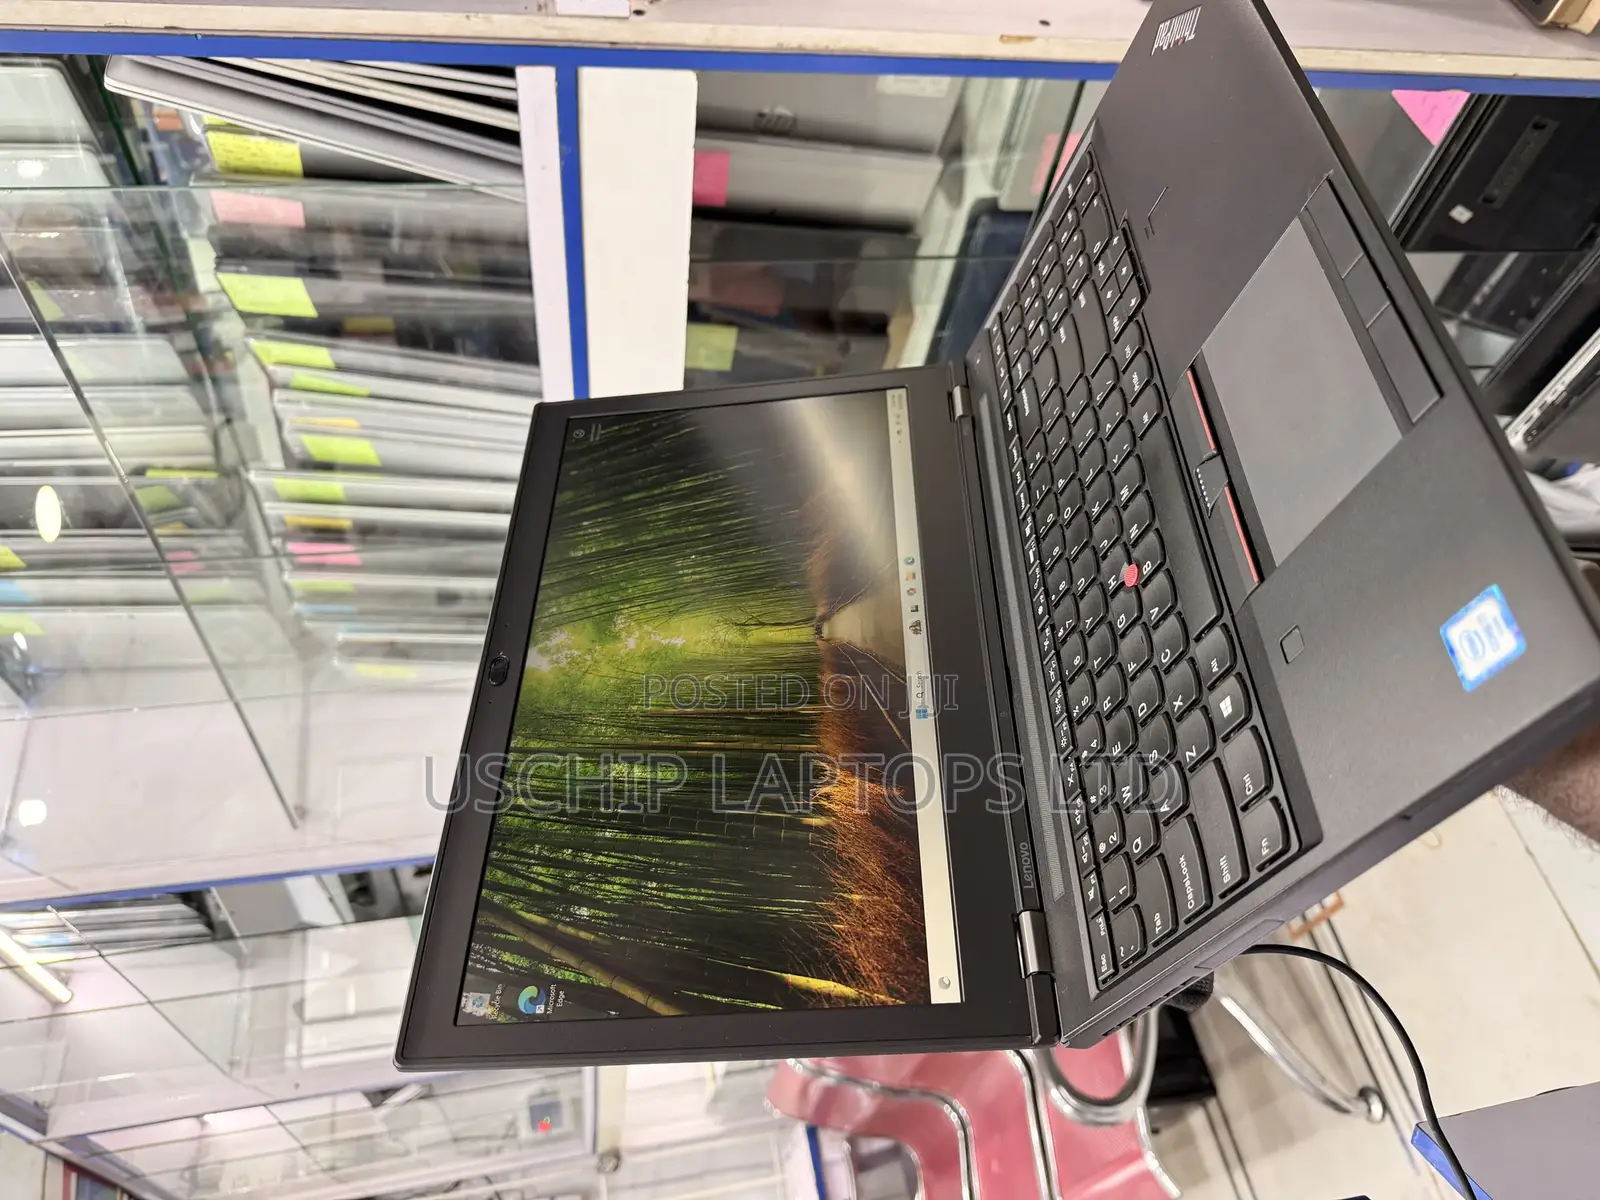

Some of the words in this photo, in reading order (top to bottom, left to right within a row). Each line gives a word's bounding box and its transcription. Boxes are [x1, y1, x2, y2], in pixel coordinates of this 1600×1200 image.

[1086, 469, 1093, 481] L
[1058, 478, 1064, 488] P
[1120, 485, 1129, 501] M
[1063, 507, 1071, 519] O
[1091, 501, 1100, 515] K
[1046, 513, 1053, 523] 0
[1130, 524, 1139, 538] N
[1053, 546, 1060, 555] 9
[1071, 546, 1078, 555] I
[1099, 539, 1108, 548] J
[1143, 561, 1152, 575] B
[1058, 581, 1066, 591] 8
[1077, 578, 1085, 590] U
[1108, 575, 1117, 590] H
[1150, 606, 1160, 620] V
[1065, 619, 1073, 629] 7
[1084, 616, 1093, 628] Y
[1117, 613, 1126, 629] G
[1073, 655, 1081, 666] 6
[1093, 657, 1102, 668] T
[1161, 649, 1171, 663] C
[1127, 661, 1137, 672] F
[1210, 658, 1219, 672] Alt
[1081, 695, 1090, 707] 5
[1102, 696, 1112, 711] R
[1173, 694, 1183, 712] X
[1138, 703, 1147, 717] D
[1090, 738, 1098, 748] 4
[1112, 741, 1122, 756] E
[1148, 749, 1158, 764] S
[1185, 745, 1197, 762] Z
[1099, 785, 1107, 795] 3
[1243, 774, 1253, 795] Ctrl
[1122, 785, 1131, 803] W
[1160, 798, 1170, 812] A
[1109, 832, 1117, 844] 2
[1132, 837, 1142, 853] Q
[1261, 838, 1270, 856] Fn
[1020, 842, 1034, 888] Lenovo
[1219, 855, 1231, 883] Shift
[1179, 854, 1195, 909] CapsLock
[1153, 913, 1163, 933] Tab
[1099, 954, 1107, 972] Esc
[494, 984, 502, 994] Bin
[547, 984, 556, 1014] Microsoft
[557, 990, 565, 1007] Edge
